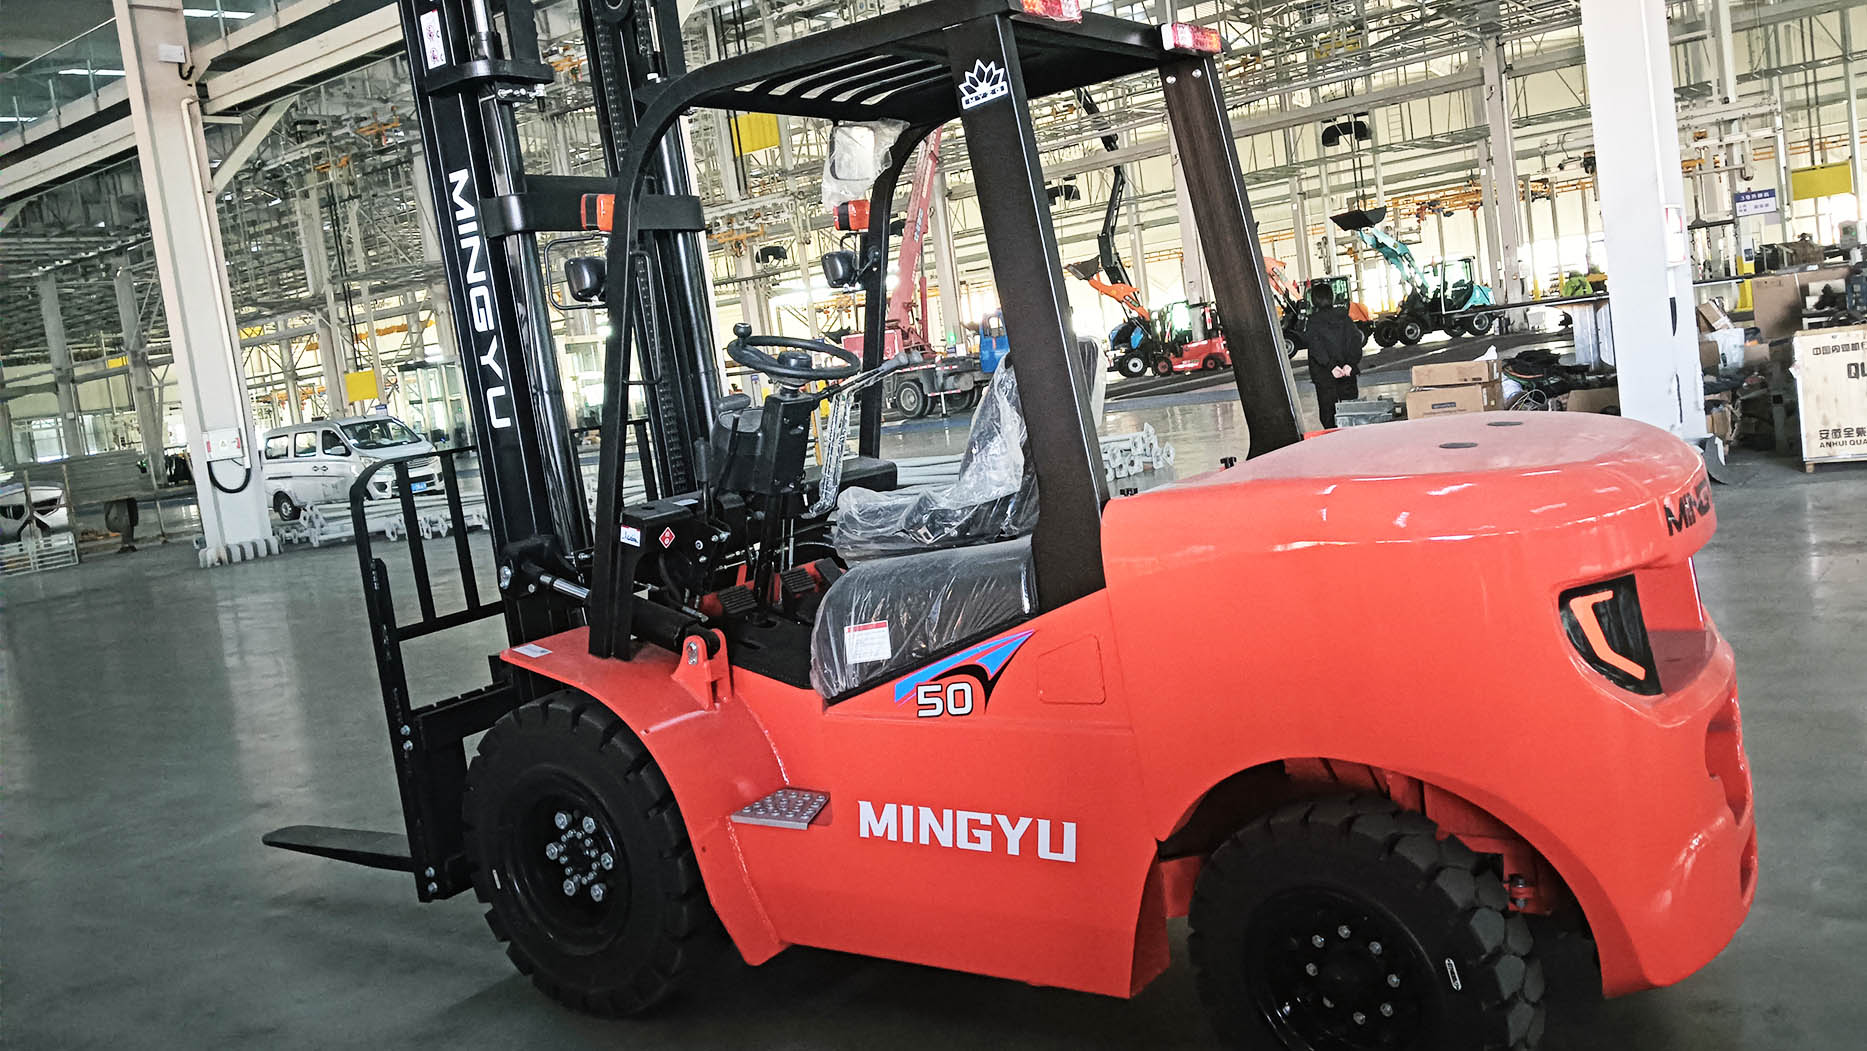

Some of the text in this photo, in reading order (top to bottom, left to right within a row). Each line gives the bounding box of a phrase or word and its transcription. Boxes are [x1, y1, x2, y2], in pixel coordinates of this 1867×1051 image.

[449, 169, 510, 429] MINGYU
[1819, 440, 1847, 448] ANHUI
[916, 682, 973, 718] 50
[859, 800, 1077, 863] MINGYU
